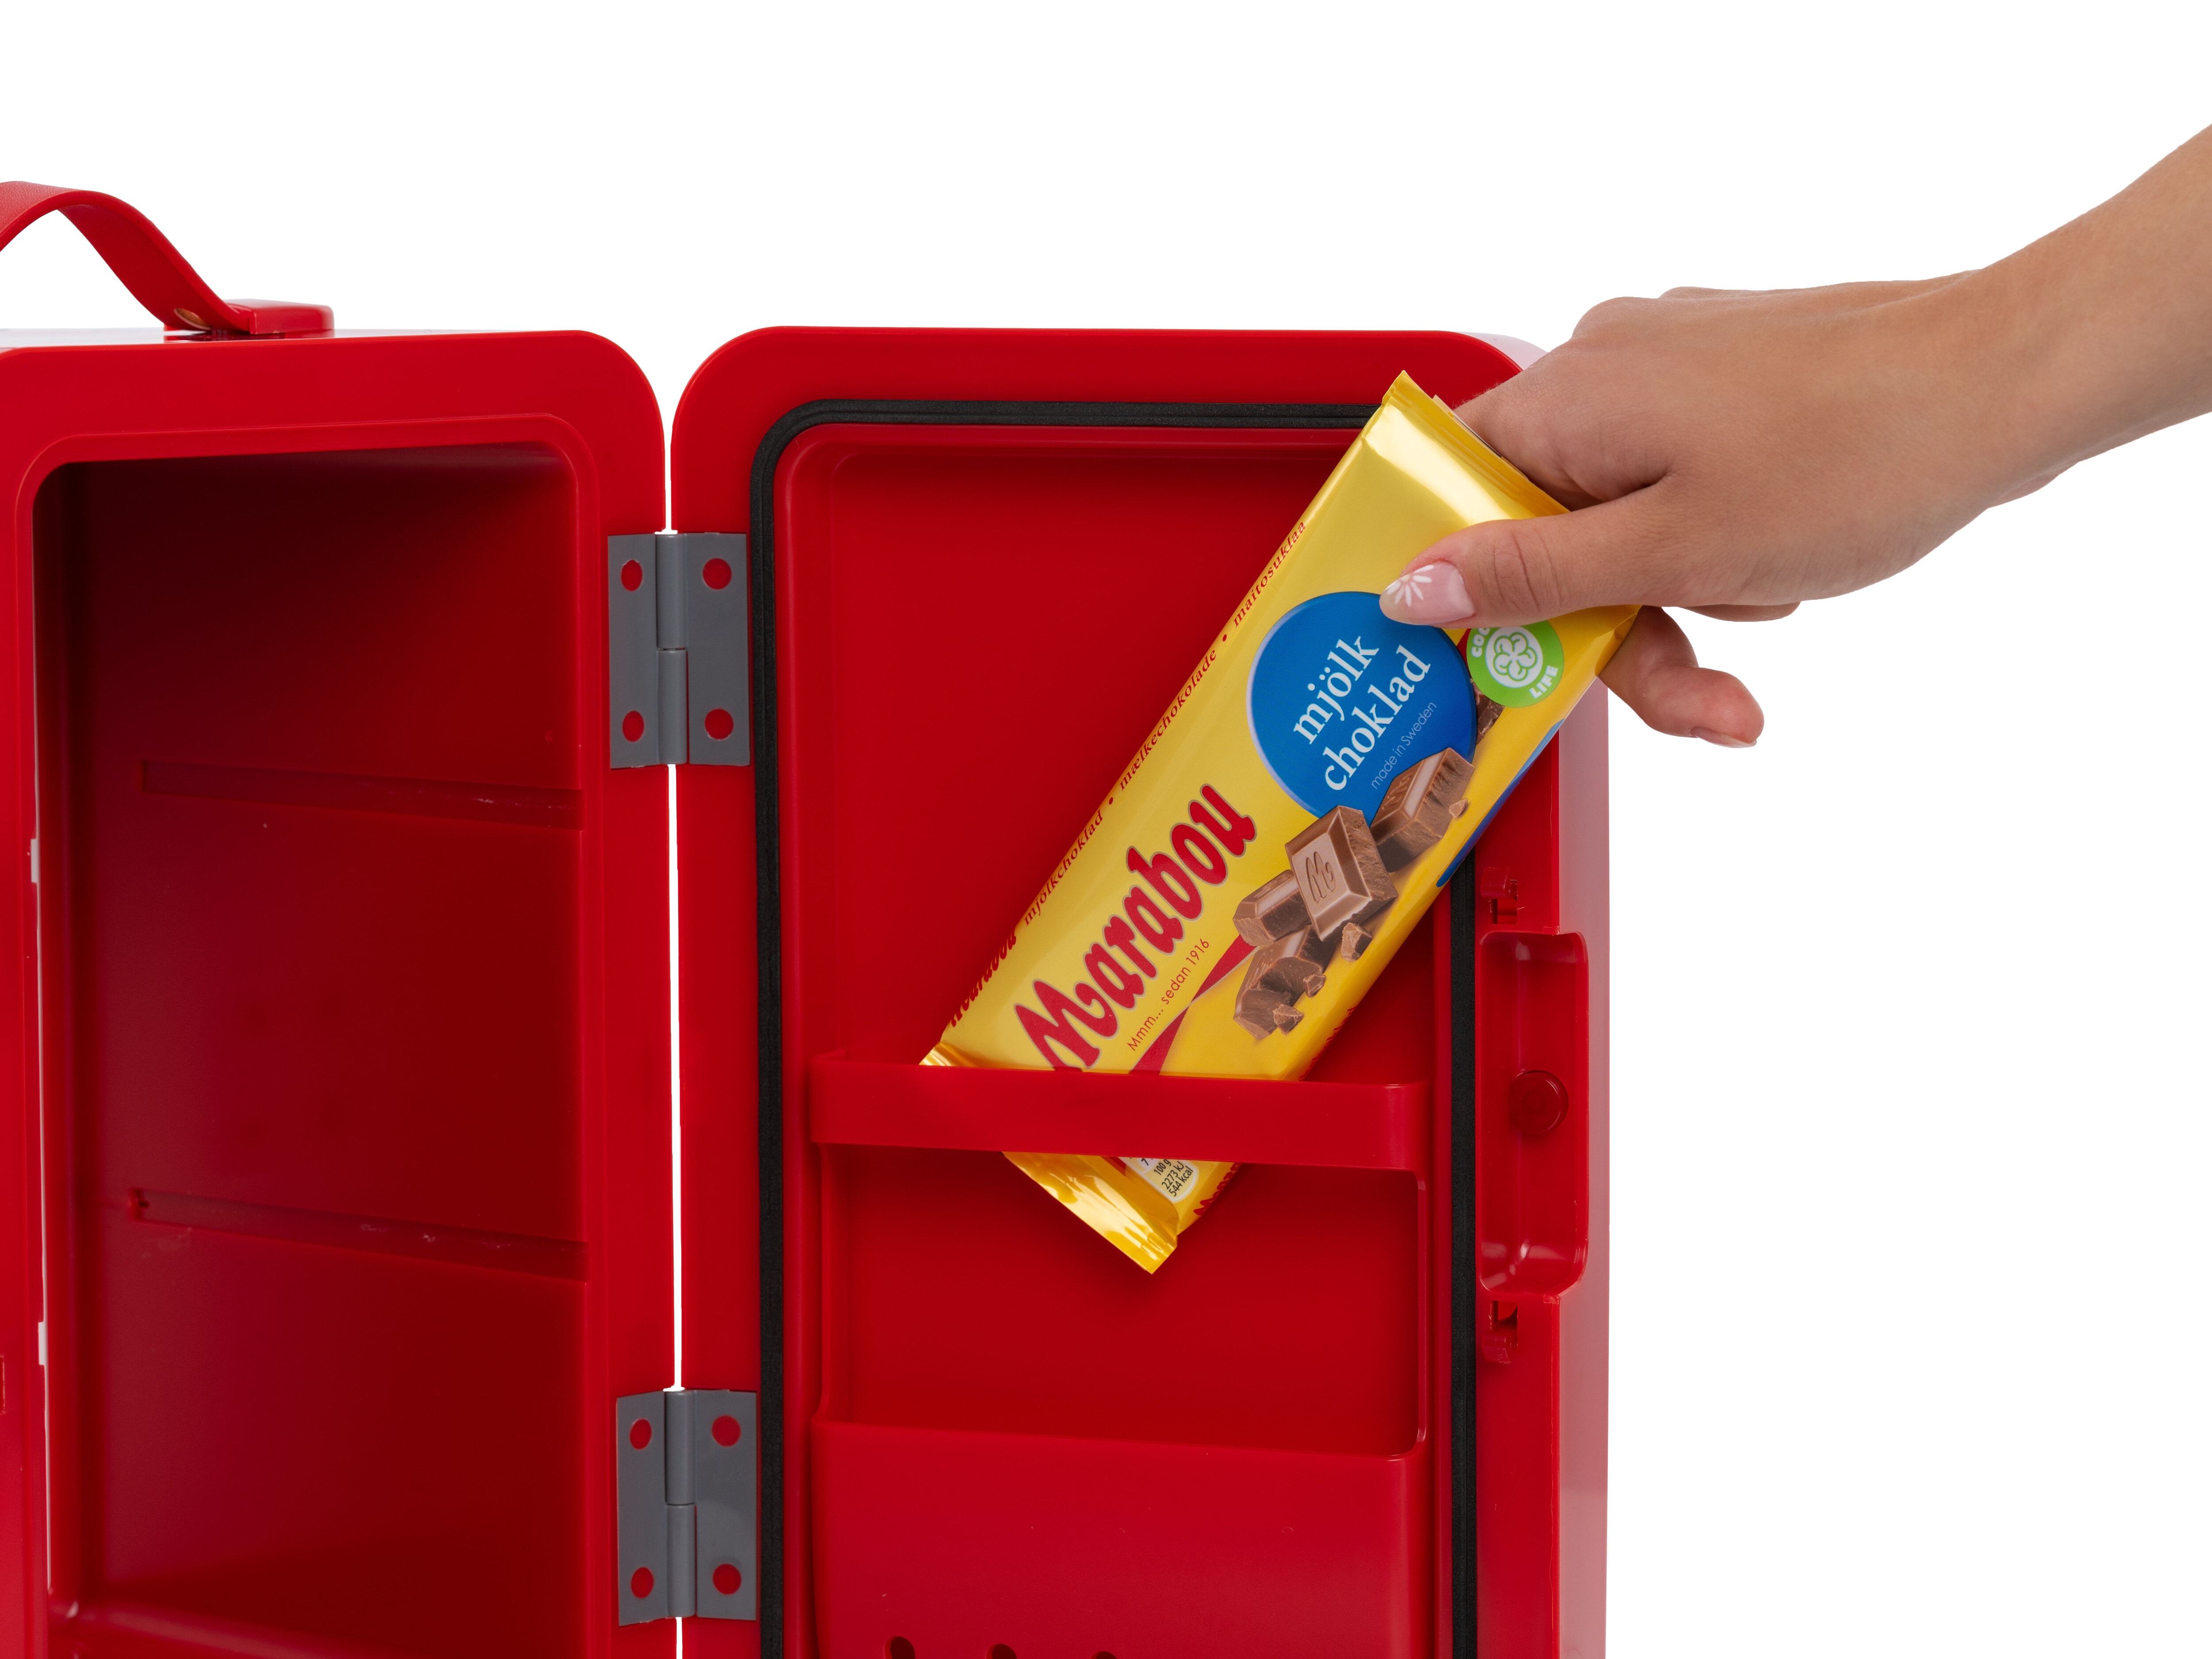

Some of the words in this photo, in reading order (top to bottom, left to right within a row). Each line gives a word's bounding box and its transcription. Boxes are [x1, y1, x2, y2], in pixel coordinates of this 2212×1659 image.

[1471, 628, 1490, 657] COC
[1528, 665, 1558, 699] LIFE
[1024, 809, 1103, 926] mjölkchoklad
[1119, 649, 1216, 791] mælkechokolade
[1233, 521, 1306, 627] maitosuklaa
[1293, 636, 1379, 745] mjölk
[1323, 645, 1431, 791] choklad
[1371, 757, 1398, 789] made
[1396, 744, 1406, 757] in
[1401, 702, 1437, 746] Sweden
[1014, 784, 1257, 1071] Marabou
[1127, 1009, 1164, 1051] Mmm...
[1161, 967, 1191, 1005] sedan
[1186, 938, 1210, 965] 1916
[1153, 1162, 1167, 1175] 100
[1161, 1169, 1179, 1190] 2273
[1173, 1161, 1185, 1172] kJ
[1168, 1180, 1183, 1197] 544
[1177, 1165, 1194, 1183] kcal
